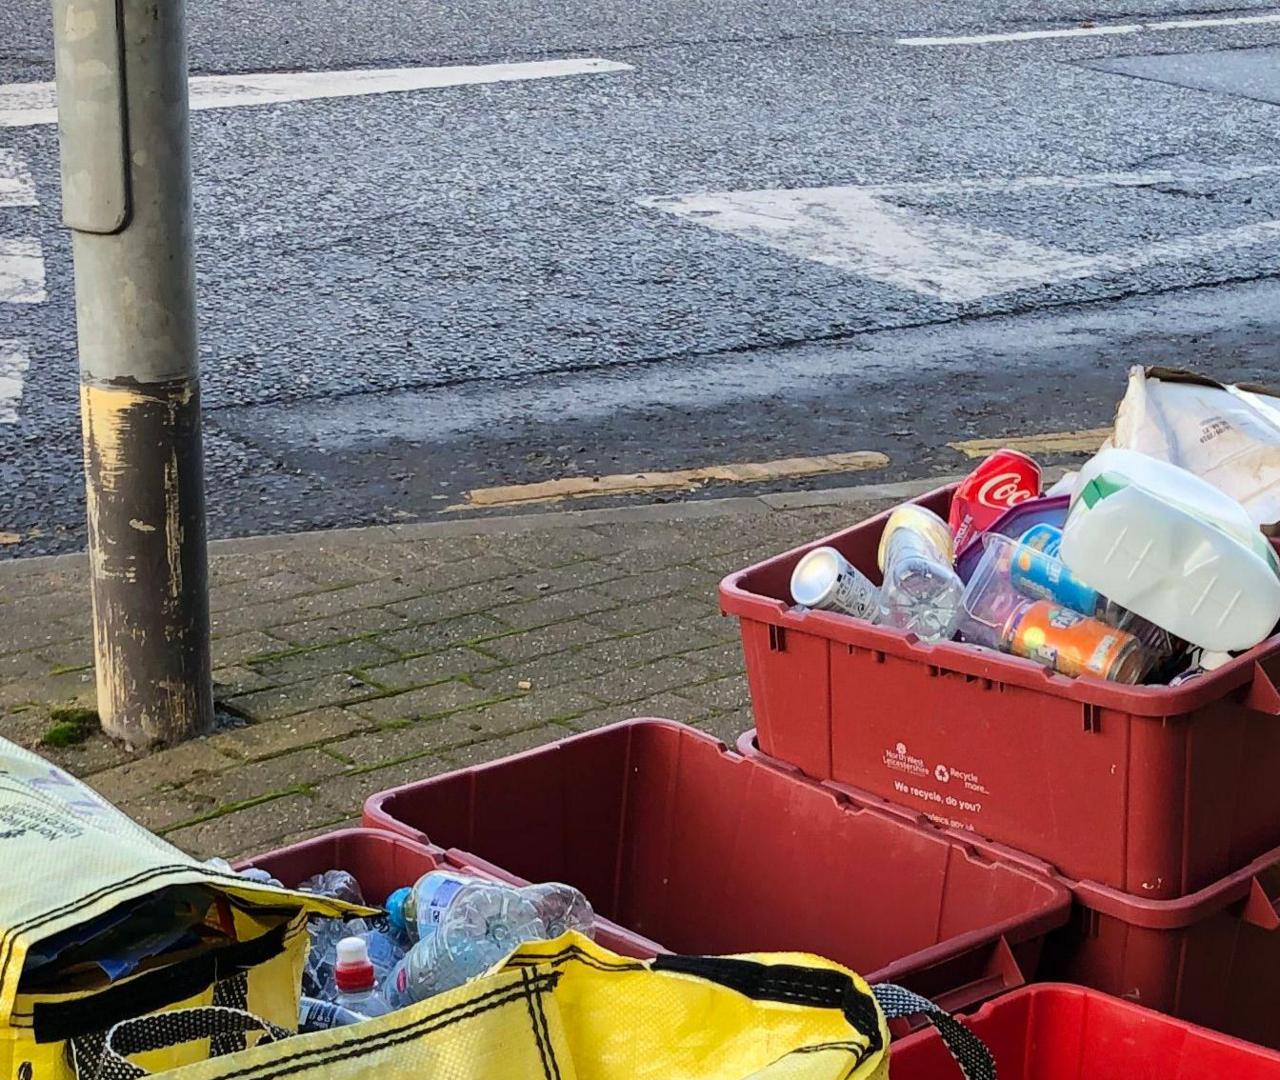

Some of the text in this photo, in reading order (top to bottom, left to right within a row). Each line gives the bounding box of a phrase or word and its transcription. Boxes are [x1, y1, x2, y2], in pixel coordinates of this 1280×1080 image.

[978, 472, 1031, 511] Coc
[950, 768, 979, 782] Recycle
[894, 780, 982, 812] We recycle, do you?
